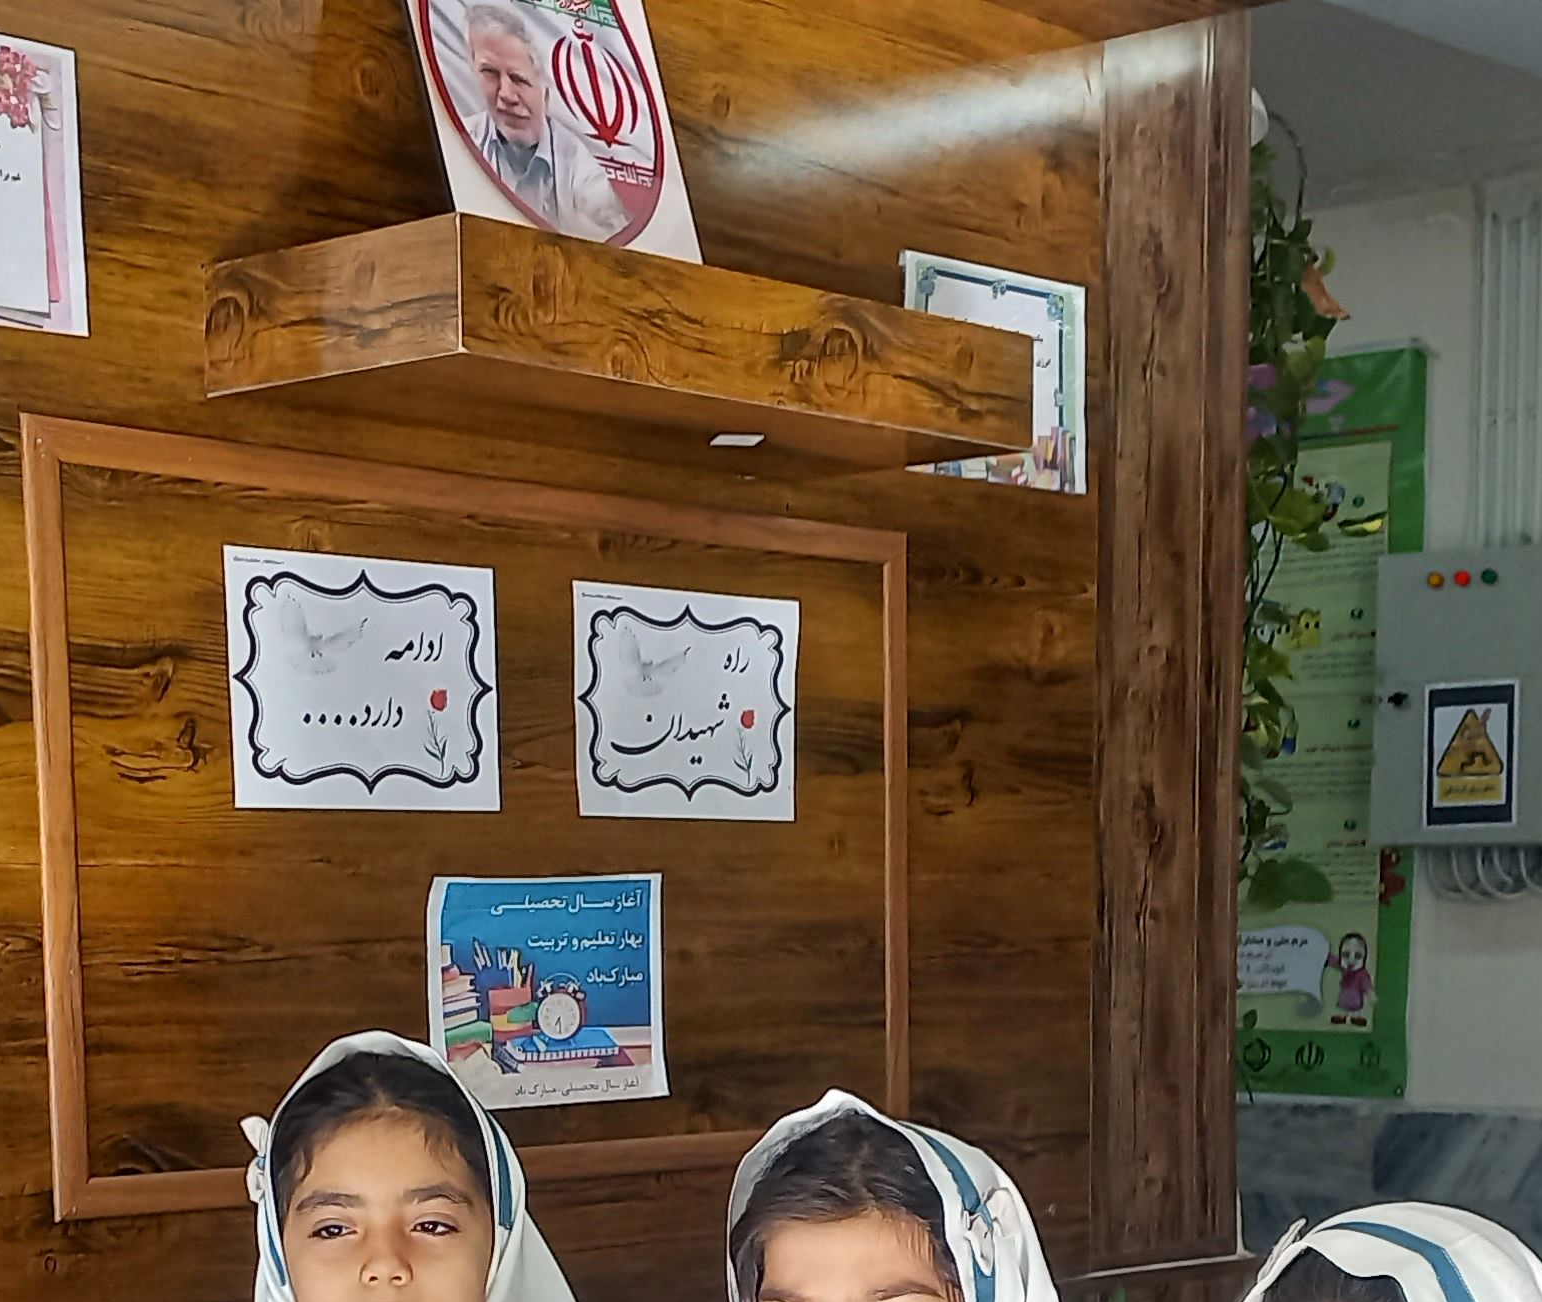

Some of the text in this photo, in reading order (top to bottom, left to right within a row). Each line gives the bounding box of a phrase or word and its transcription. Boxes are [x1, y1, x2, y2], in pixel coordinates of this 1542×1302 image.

[385, 632, 443, 662] ادامه
[724, 646, 750, 673] راه
[610, 693, 730, 765] شهیدان
[491, 890, 642, 915] آغاز سال تحصیلی
[527, 930, 643, 951] بهار تعلیم و تربیت
